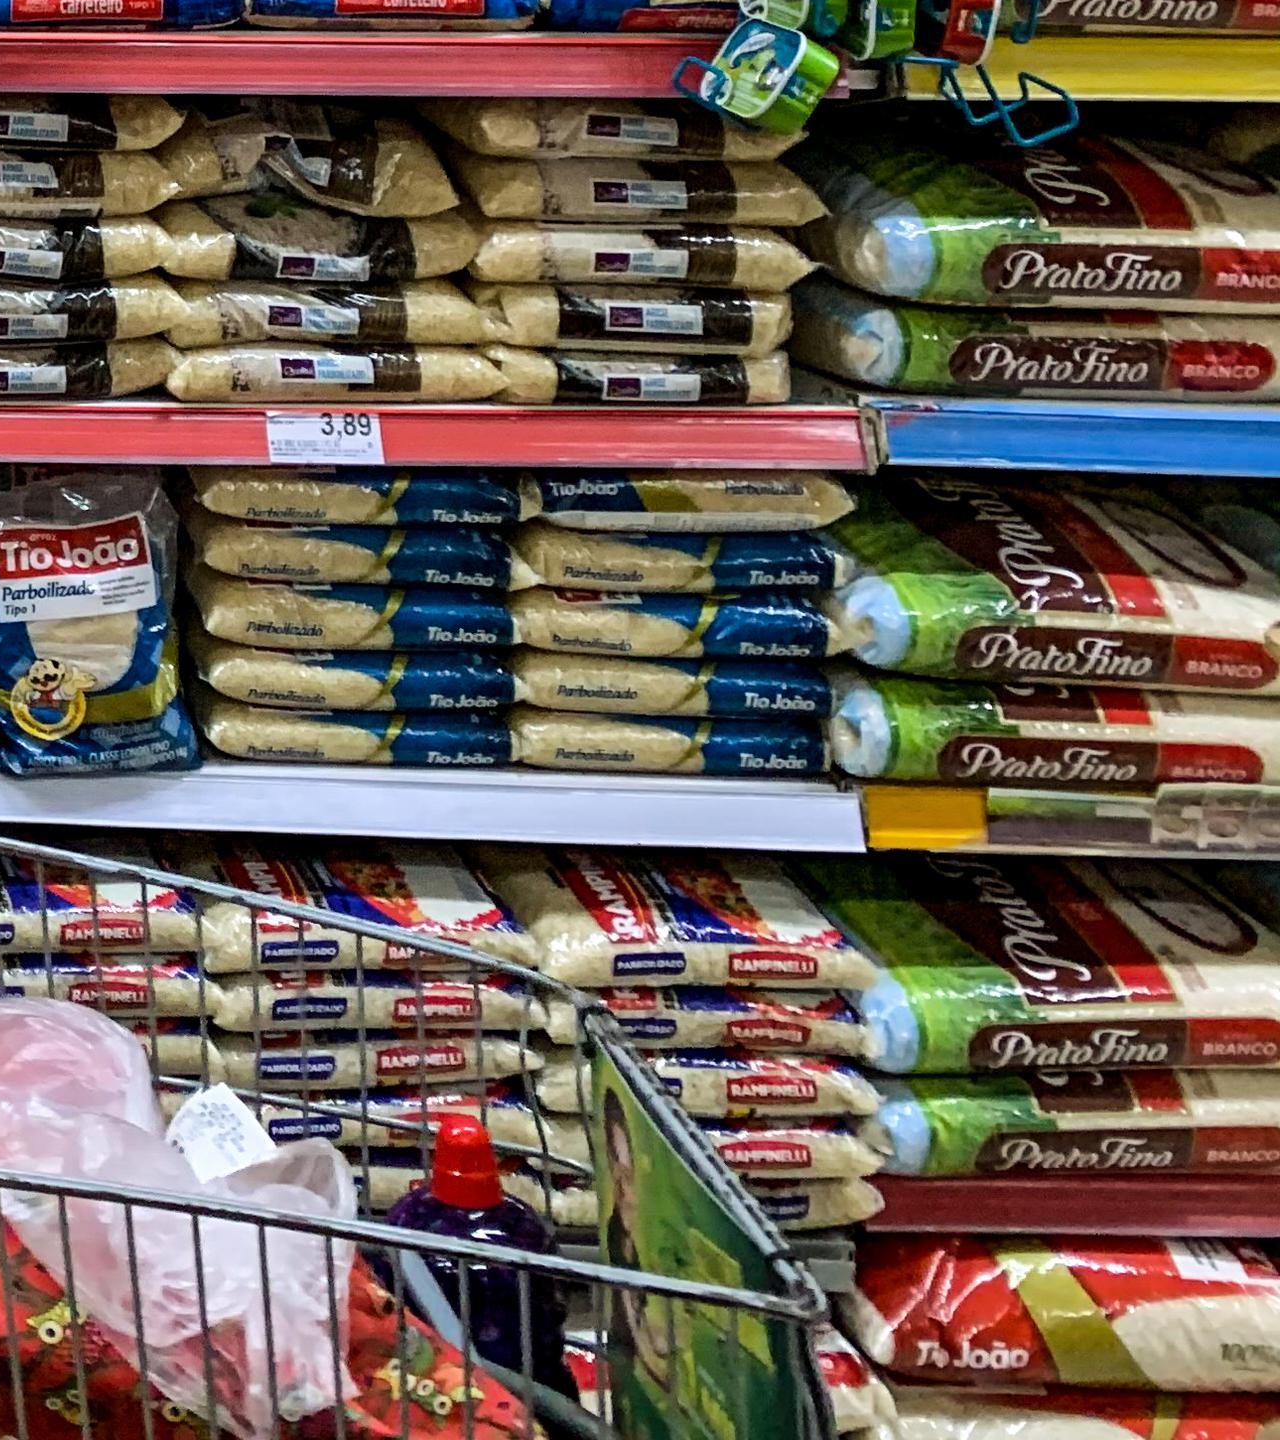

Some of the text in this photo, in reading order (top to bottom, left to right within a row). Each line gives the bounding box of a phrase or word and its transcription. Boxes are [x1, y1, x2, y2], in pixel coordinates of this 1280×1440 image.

[1182, 365, 1260, 380] BRANCO
[320, 413, 372, 441] 3,89
[0, 536, 140, 571] Tio João
[2, 580, 95, 602] Parboilizado
[1185, 660, 1263, 679] BRANCO
[733, 959, 815, 974] RAMPINELLI
[1202, 1041, 1277, 1057] BRANCO
